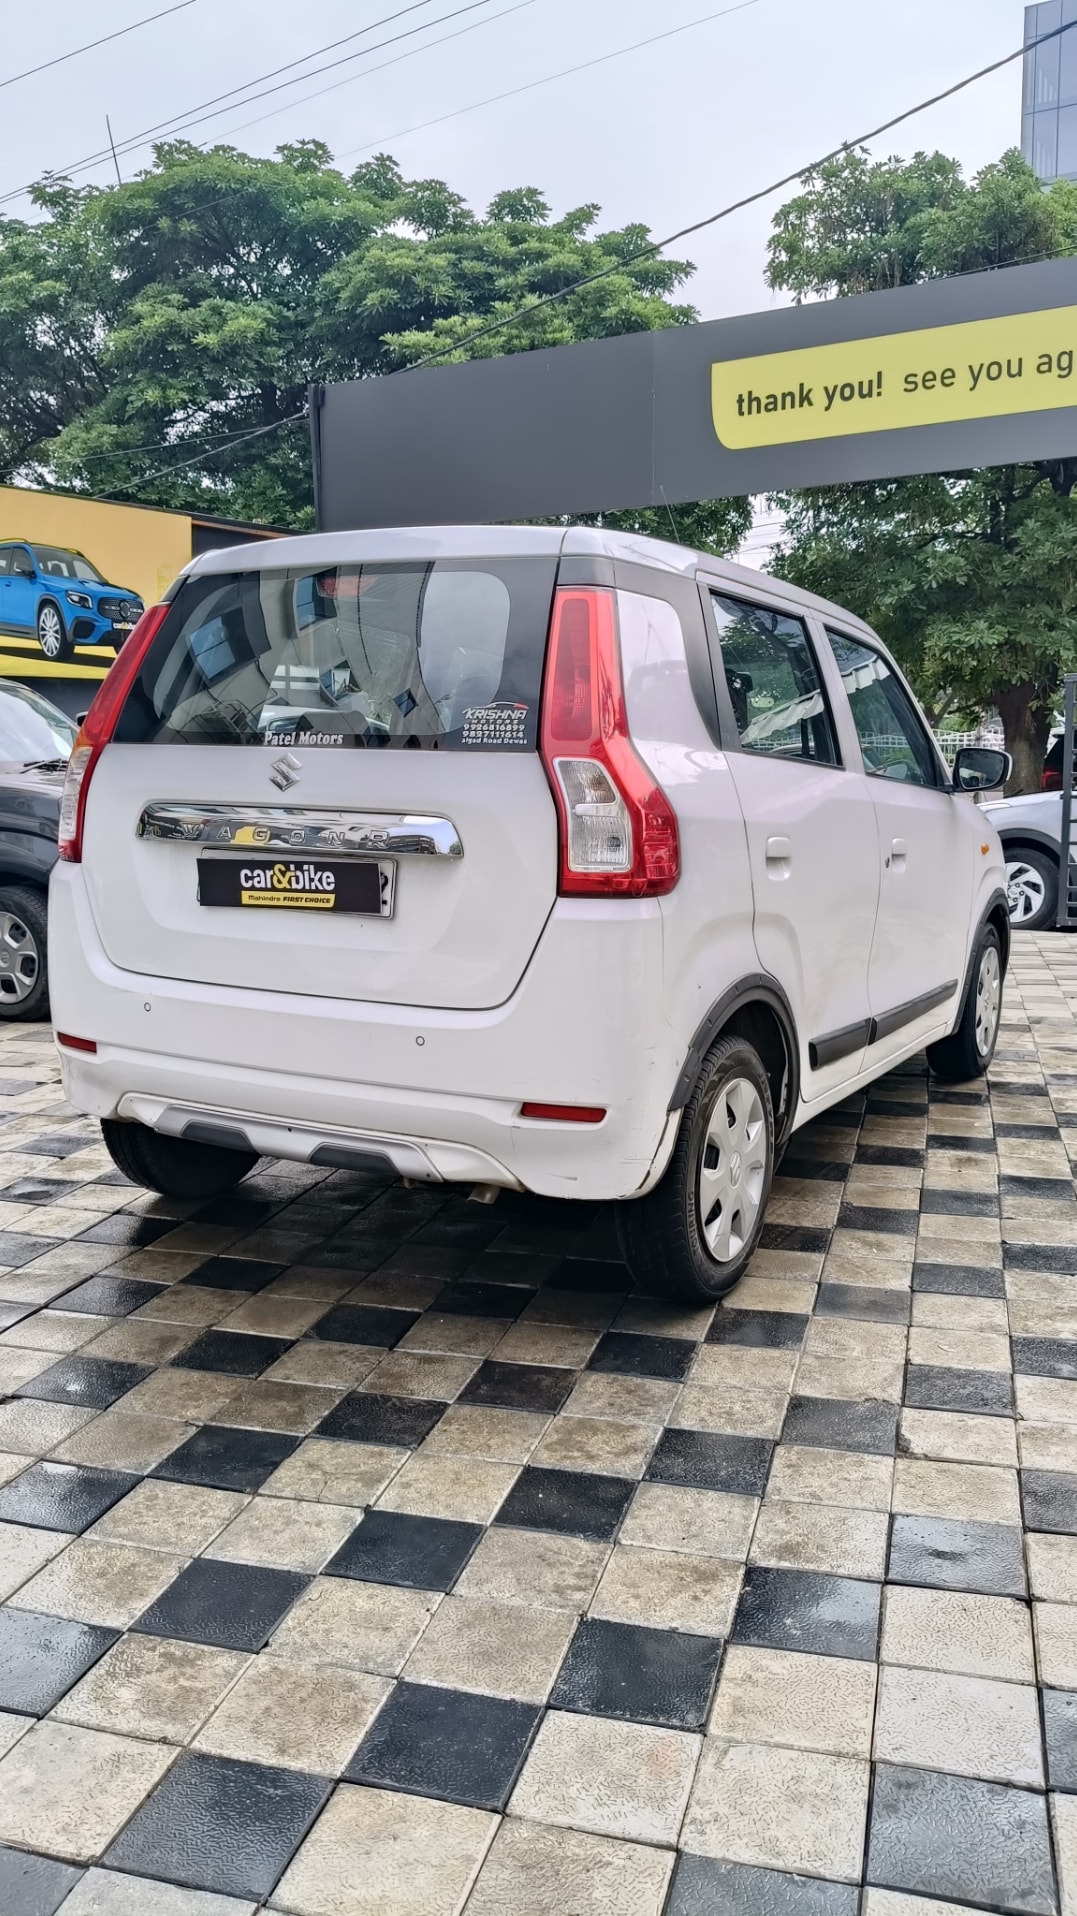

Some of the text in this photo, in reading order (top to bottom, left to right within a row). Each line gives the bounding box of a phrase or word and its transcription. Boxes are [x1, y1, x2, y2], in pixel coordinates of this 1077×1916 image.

[736, 383, 814, 417] thank
[824, 370, 883, 412] you!
[903, 367, 956, 393] see
[968, 356, 1023, 392] you
[462, 708, 527, 719] KRISHNA
[463, 723, 525, 731] 9926816899
[263, 730, 344, 746] Patel Motors
[462, 730, 524, 738] 9827111614
[240, 863, 336, 891] car&bike
[248, 895, 281, 903] Mahindra
[282, 896, 304, 904] FIRST
